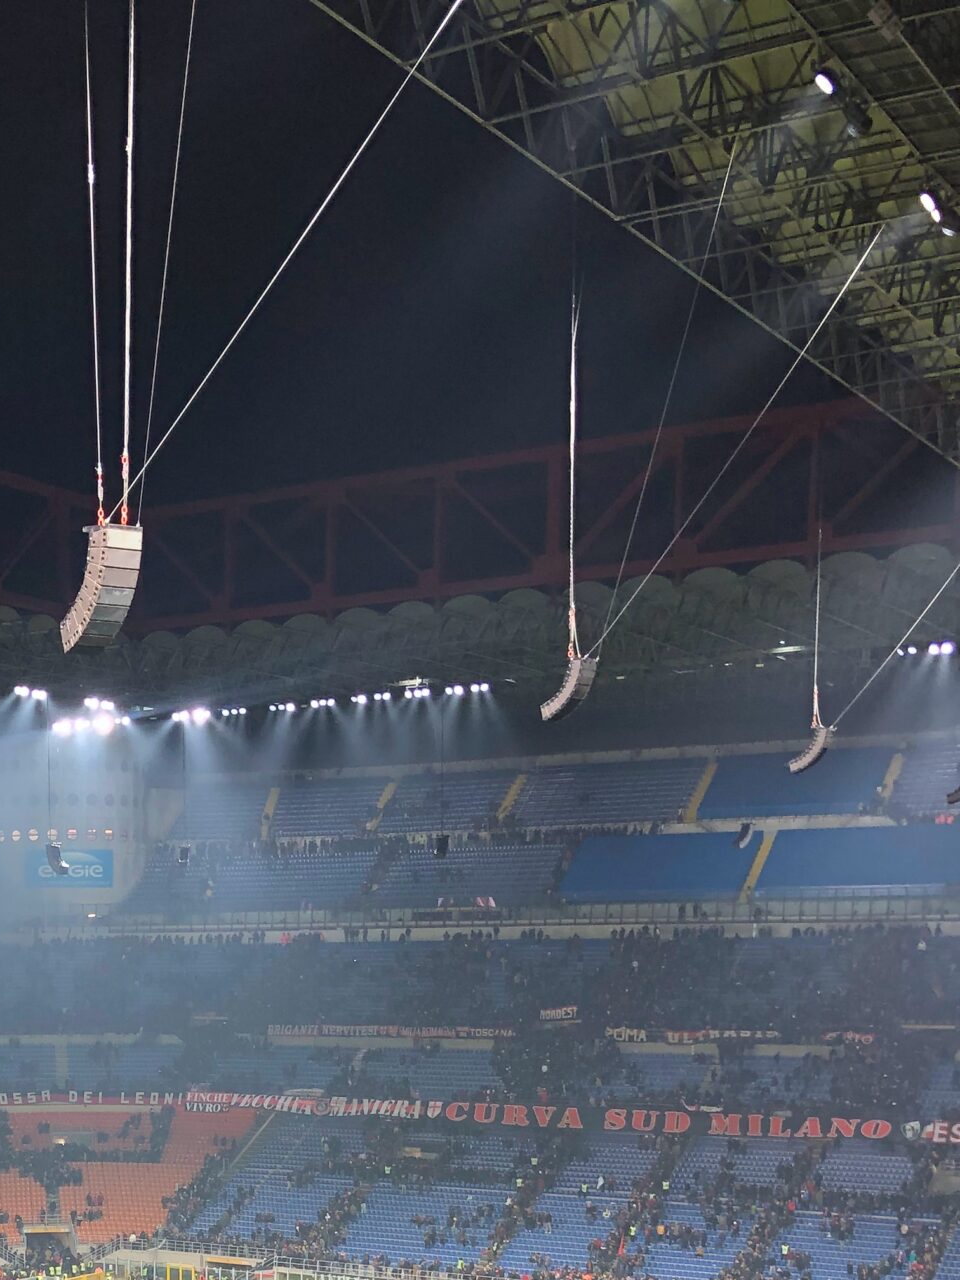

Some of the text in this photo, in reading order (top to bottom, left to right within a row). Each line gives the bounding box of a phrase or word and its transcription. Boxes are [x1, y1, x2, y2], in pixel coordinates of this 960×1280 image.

[69, 1092, 102, 1104] DEI
[121, 1092, 182, 1105] LEONI
[445, 1102, 892, 1139] CURVA SUD MILANO
